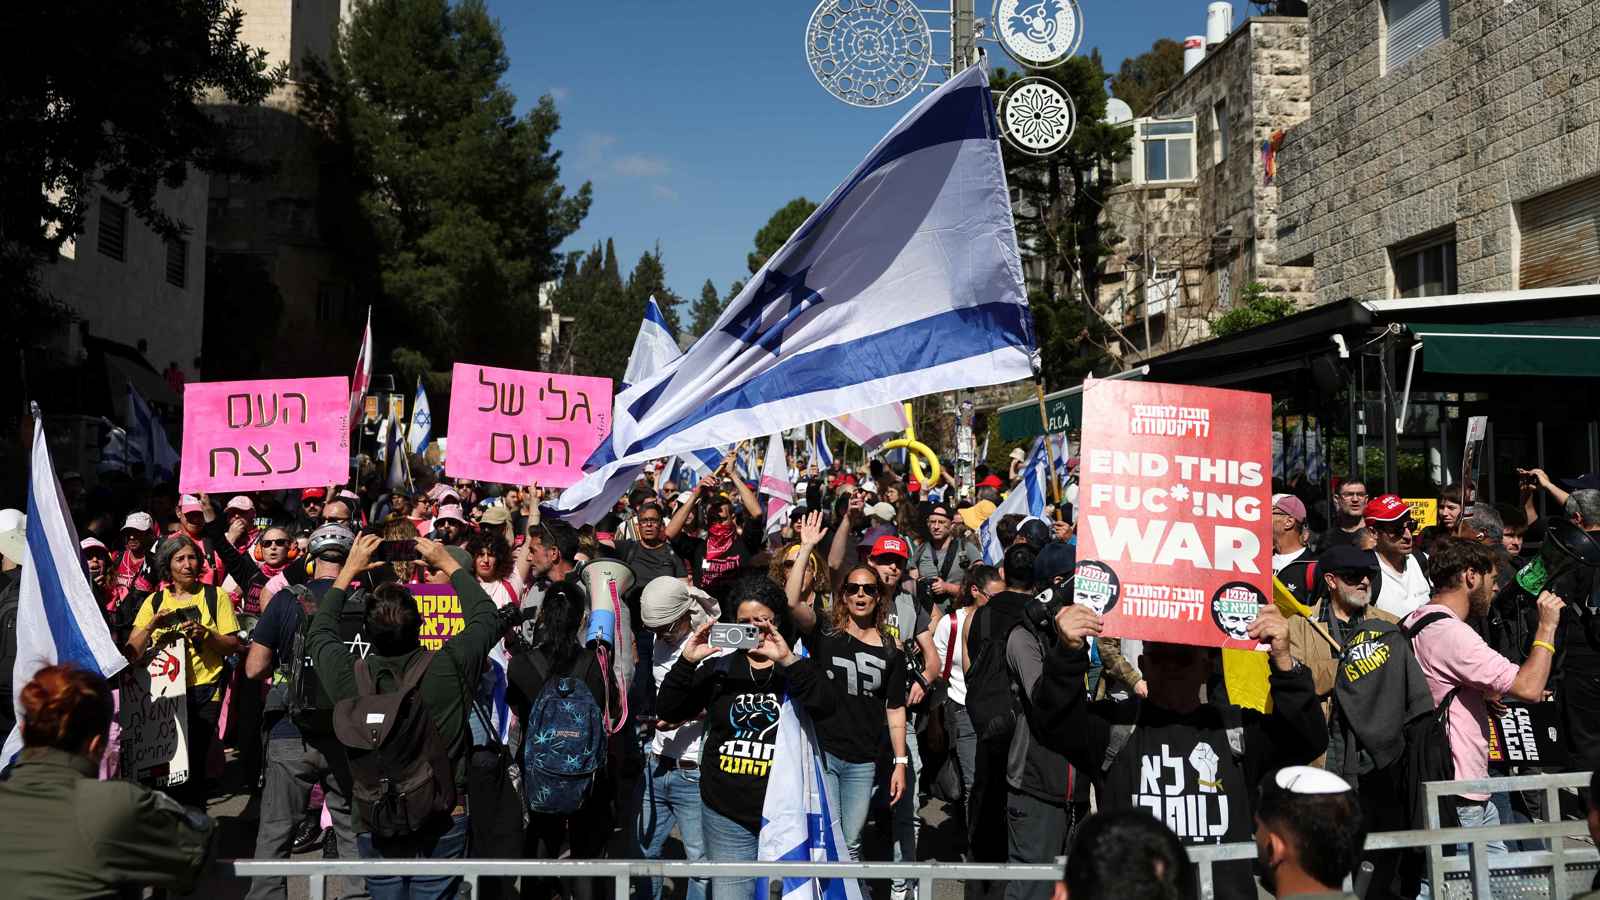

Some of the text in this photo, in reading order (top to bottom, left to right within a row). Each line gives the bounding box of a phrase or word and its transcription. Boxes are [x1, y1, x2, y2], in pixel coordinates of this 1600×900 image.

[227, 392, 308, 428] העם
[478, 368, 592, 424] גלי של
[209, 440, 318, 478] ינצח
[490, 432, 570, 467] העם
[1088, 449, 1264, 487] END THIS
[1087, 515, 1262, 575] WAR
[1123, 584, 1205, 602] חובה להתנגד
[719, 740, 777, 760] חובה
[1514, 707, 1540, 761] למלחמה
[720, 754, 774, 777] התנגד
[1140, 743, 1185, 796] לא
